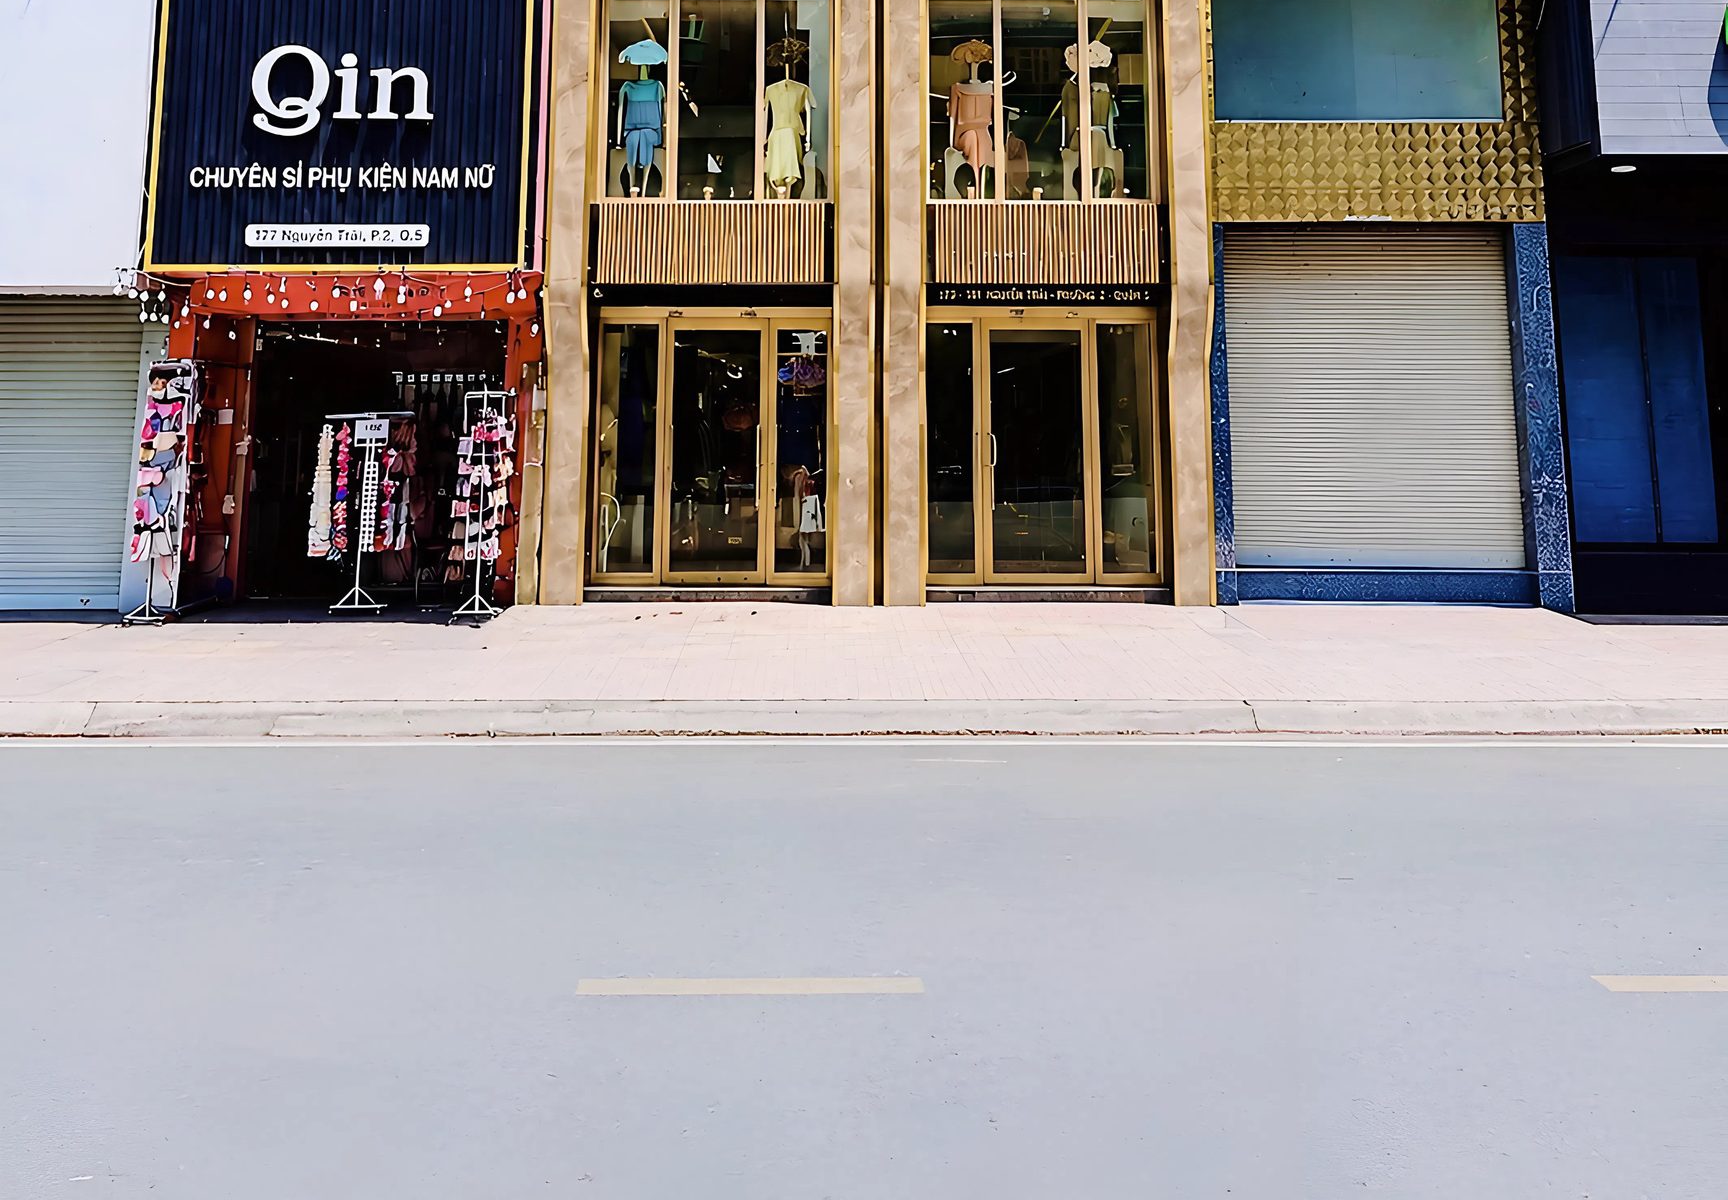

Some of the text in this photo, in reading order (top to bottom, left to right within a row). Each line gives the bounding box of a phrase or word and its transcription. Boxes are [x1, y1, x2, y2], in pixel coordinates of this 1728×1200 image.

[251, 44, 434, 137] Qin
[189, 162, 277, 188] CHUYÊN
[308, 166, 352, 193] PHỤ
[358, 162, 407, 192] KIỆN
[412, 166, 459, 189] NAM
[464, 163, 496, 189] NỮ
